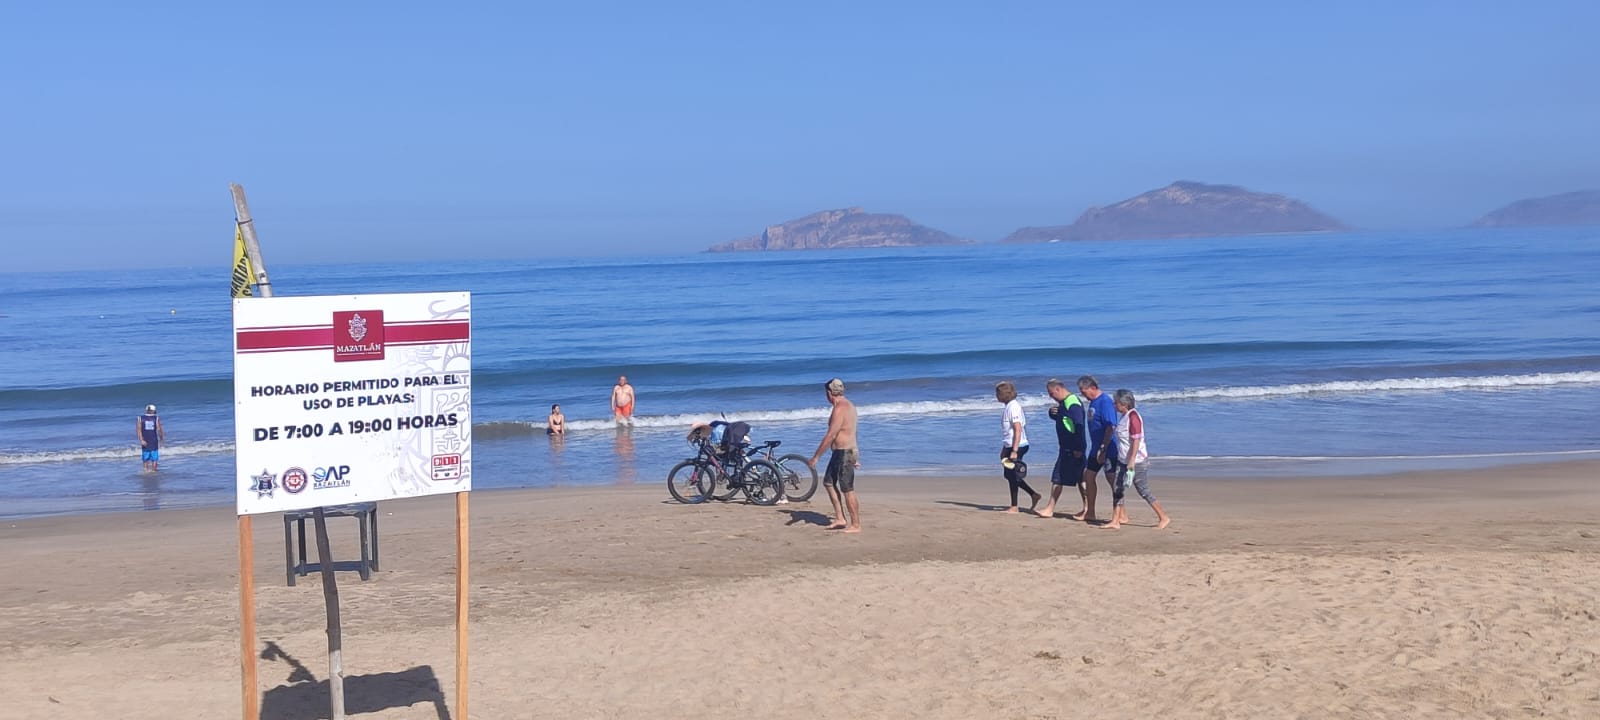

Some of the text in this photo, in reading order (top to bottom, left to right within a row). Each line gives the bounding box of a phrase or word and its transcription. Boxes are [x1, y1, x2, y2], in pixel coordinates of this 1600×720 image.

[336, 342, 381, 353] MAZATLÁN
[251, 382, 319, 397] HORARIO
[323, 378, 400, 393] PERMITIDO
[404, 376, 439, 388] PARA
[443, 374, 459, 385] EL
[303, 393, 415, 411] USO DE PLAYAS:
[253, 413, 458, 442] DE 7:00 A 19:00 HORAS
